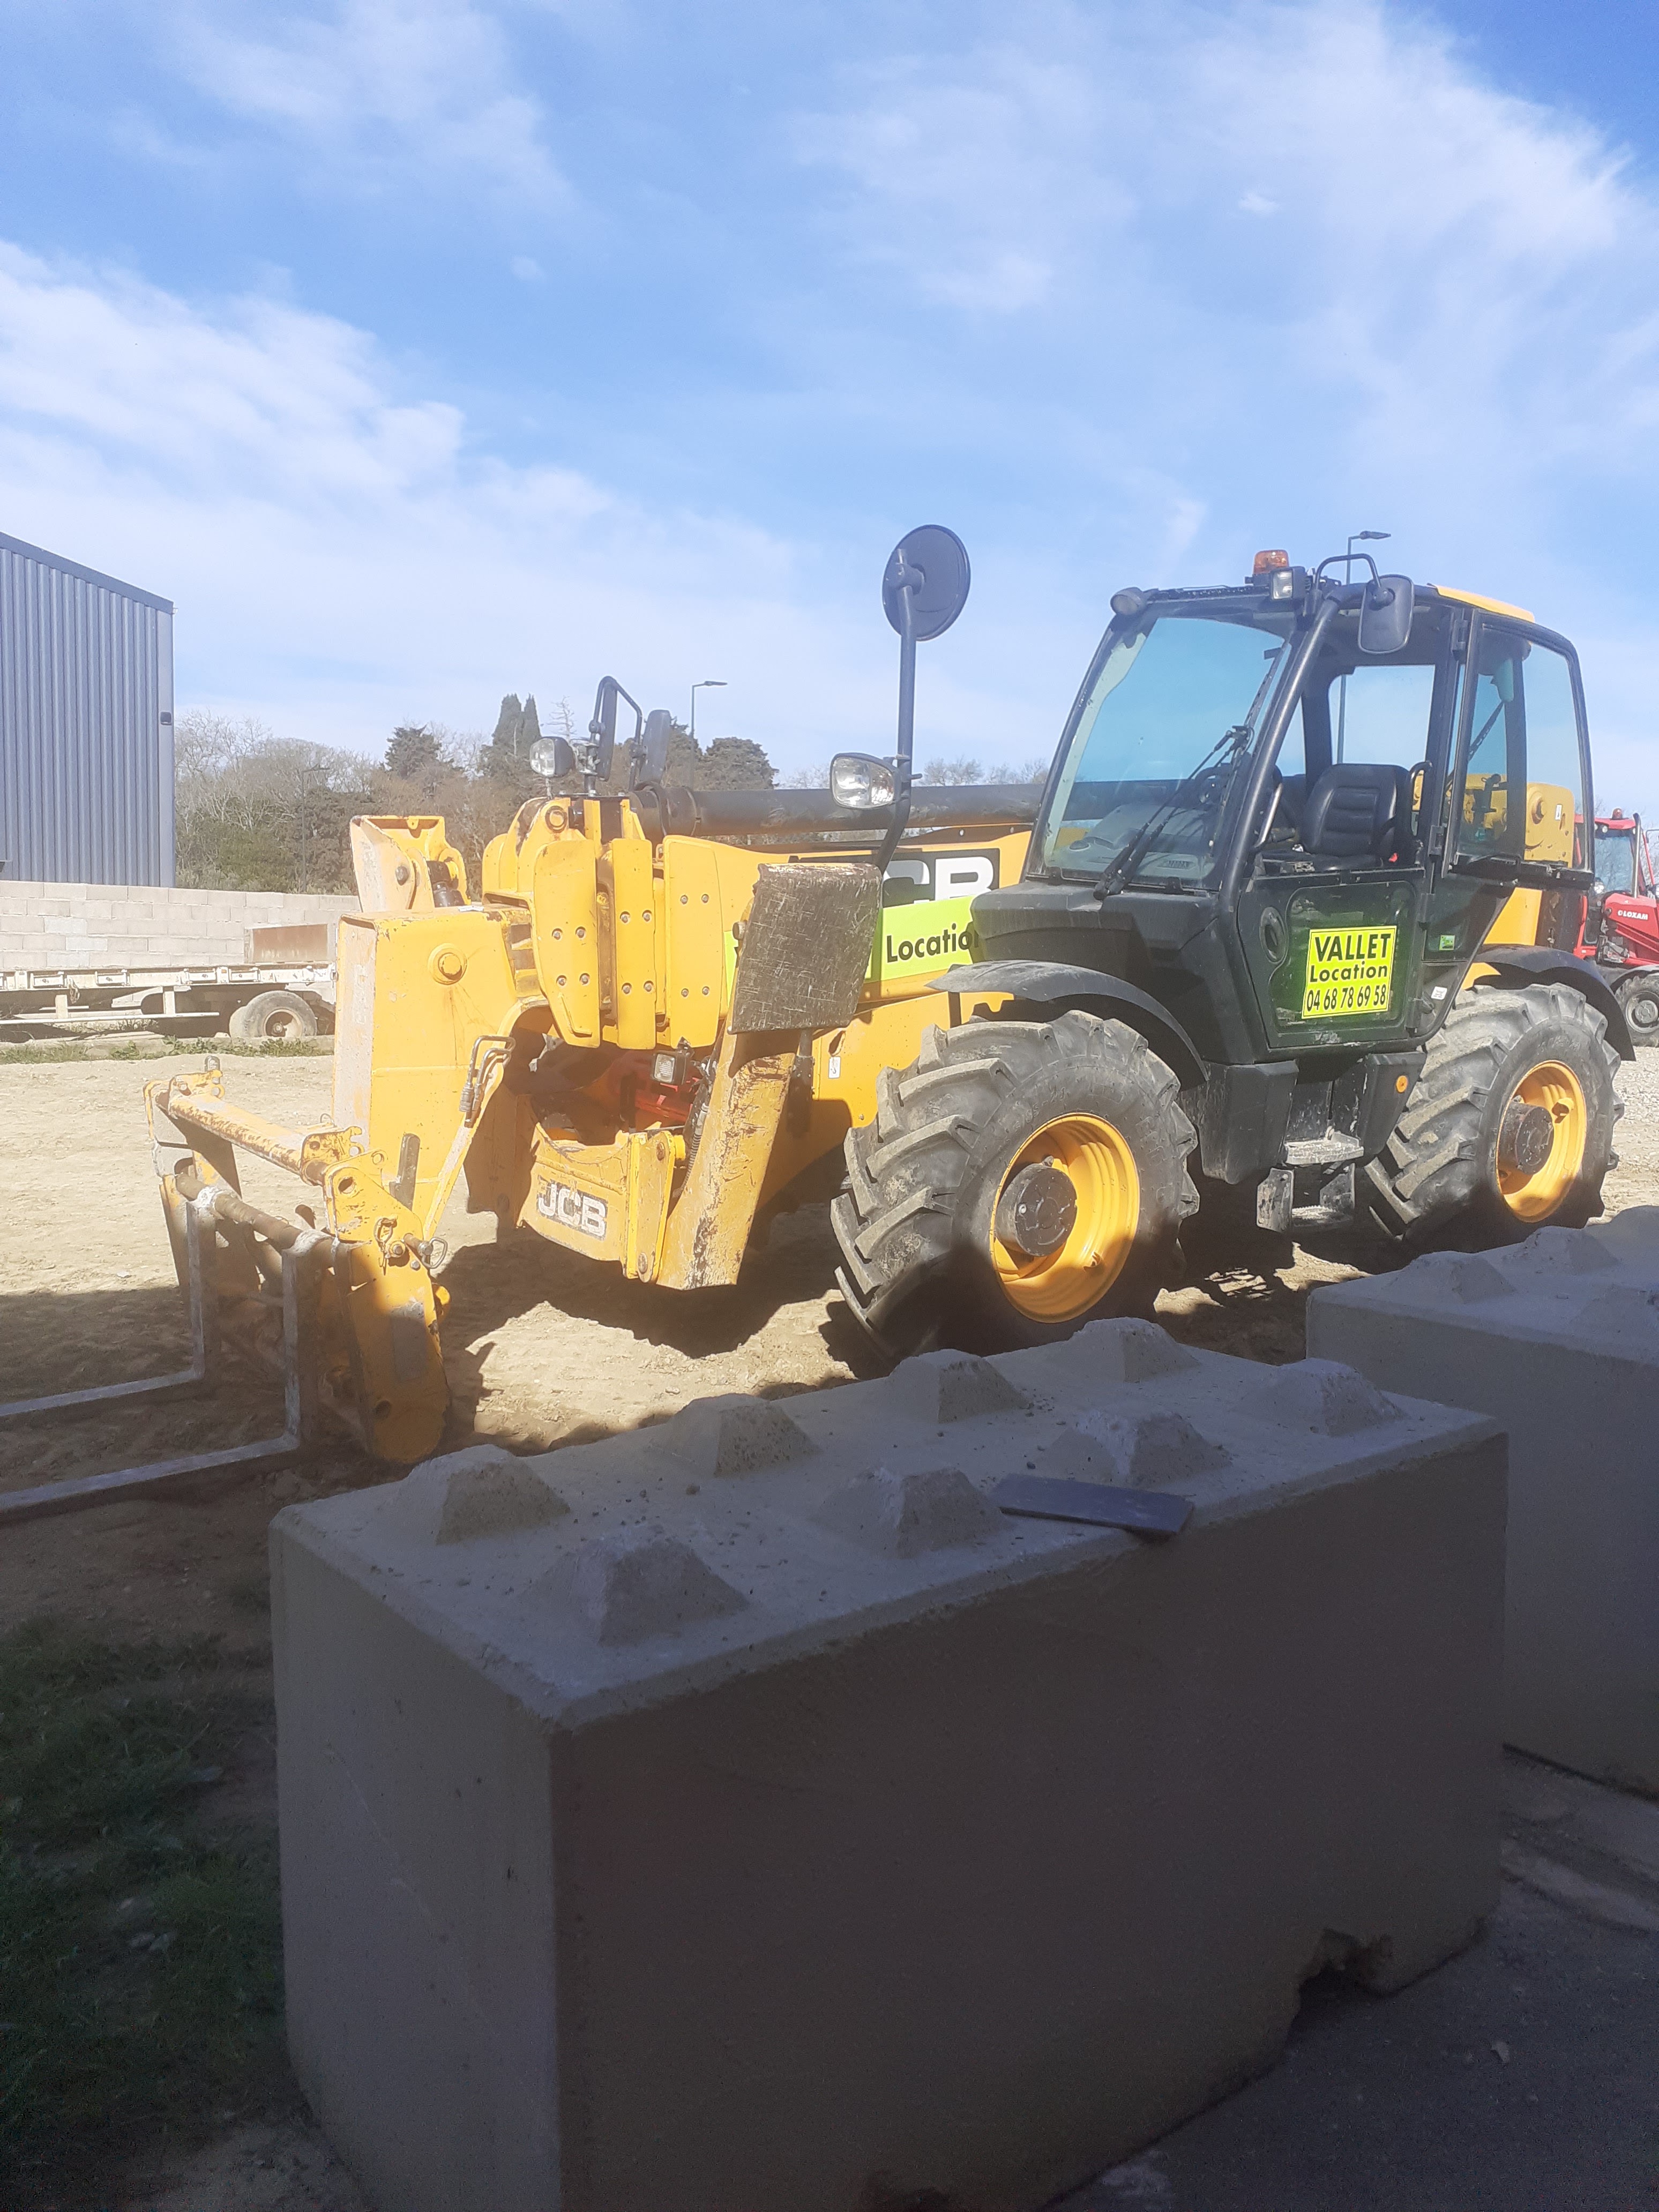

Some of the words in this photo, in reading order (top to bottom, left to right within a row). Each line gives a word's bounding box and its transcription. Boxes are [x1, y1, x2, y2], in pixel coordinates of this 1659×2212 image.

[1315, 933, 1391, 962] VALLET
[1310, 961, 1388, 983] Location
[1306, 990, 1320, 1012] 04
[1324, 989, 1337, 1010] 68
[1340, 987, 1354, 1008] 78
[1357, 985, 1371, 1007] 69
[1373, 984, 1387, 1006] 58
[538, 1183, 606, 1236] JCB
